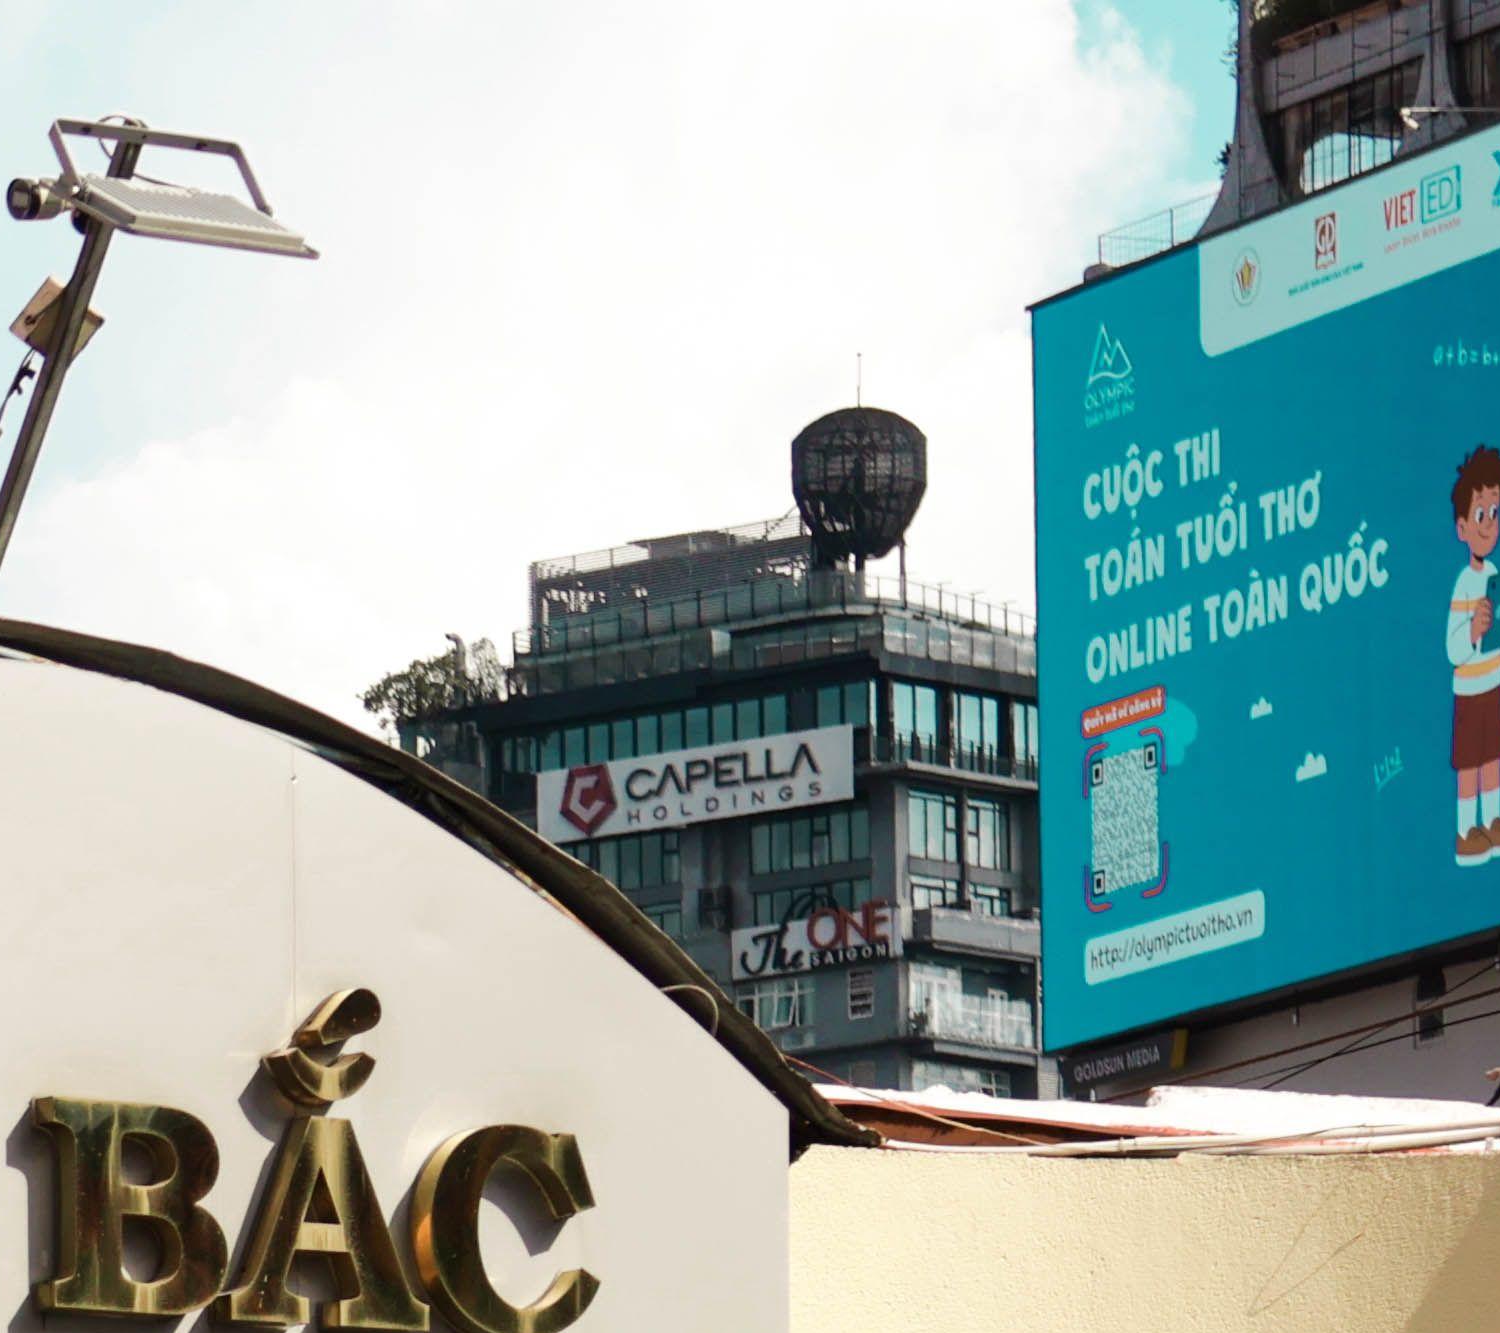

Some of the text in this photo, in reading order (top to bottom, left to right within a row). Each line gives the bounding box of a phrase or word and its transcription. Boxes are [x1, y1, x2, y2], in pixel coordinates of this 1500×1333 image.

[1384, 189, 1417, 231] VIET
[1084, 377, 1135, 411] OLYMPIC
[1083, 427, 1220, 520] CUỘC THI
[1084, 470, 1322, 602] TOÁN TUỔI THƠ
[1086, 521, 1389, 683] ONLINE TOÀN QUỐC
[625, 743, 822, 801] CAPELLA
[627, 781, 823, 825] HOLDINGS
[807, 900, 890, 950] ONE
[1090, 907, 1254, 971] http://olympictuoitho.vn
[809, 944, 891, 969] SAIGON
[1073, 1044, 1161, 1083] GOLDSUN MEDIA
